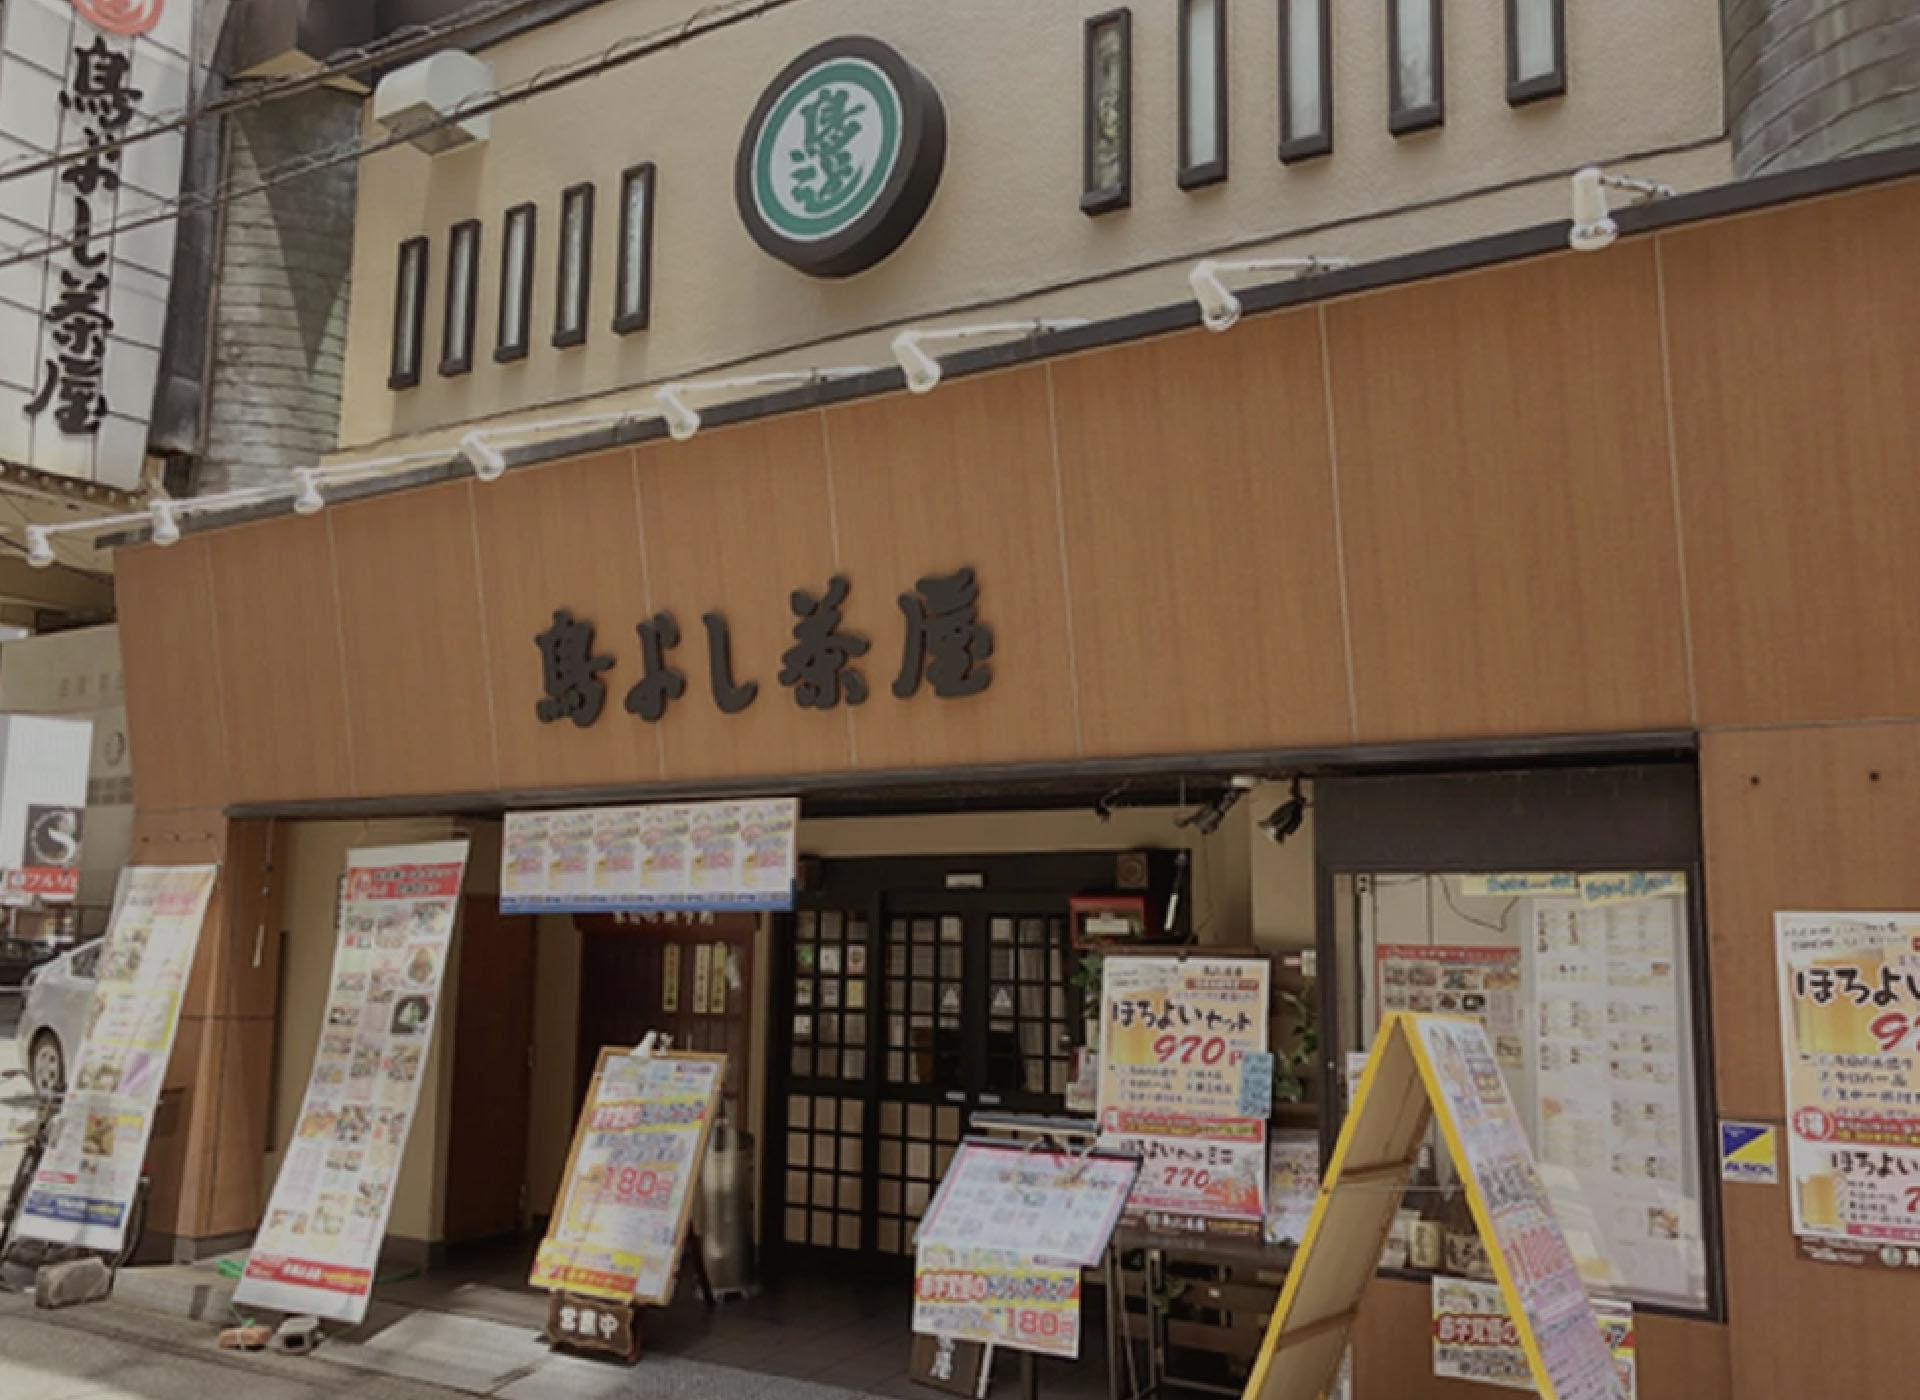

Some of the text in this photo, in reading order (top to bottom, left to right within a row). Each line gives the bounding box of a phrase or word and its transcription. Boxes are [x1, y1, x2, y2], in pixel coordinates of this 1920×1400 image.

[23, 36, 143, 435] 鳥よし茶屋
[535, 566, 994, 728] 鳥よし茶屋
